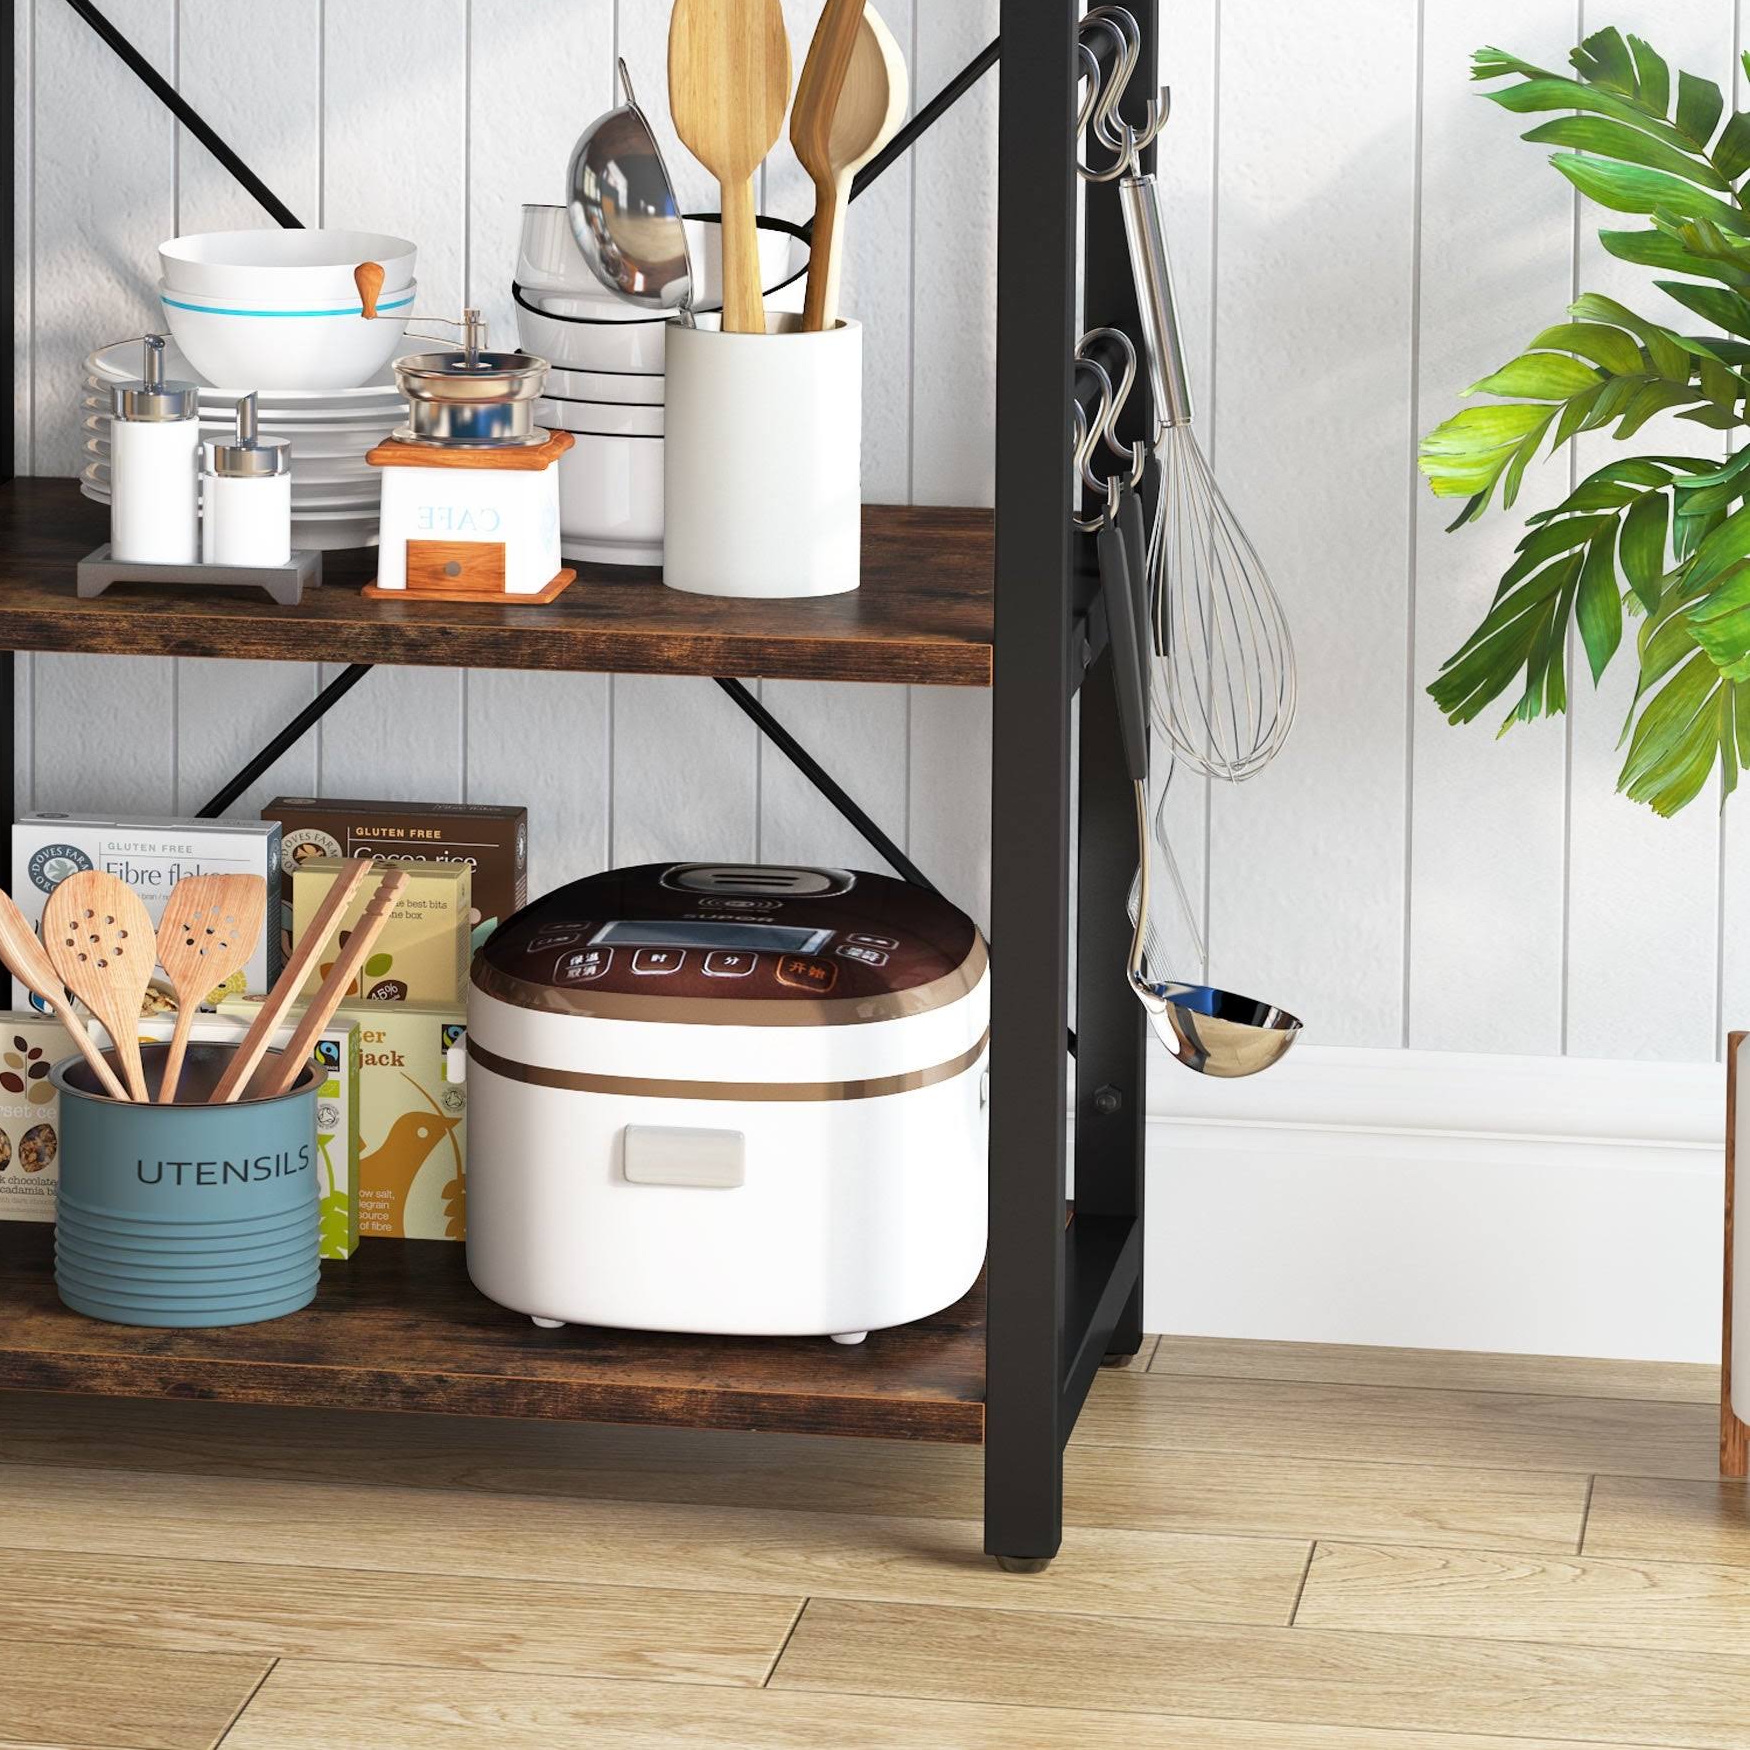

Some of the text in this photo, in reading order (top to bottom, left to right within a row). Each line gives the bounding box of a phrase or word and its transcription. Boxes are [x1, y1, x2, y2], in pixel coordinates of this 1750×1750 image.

[356, 827, 441, 839] GLUTEN FREE
[107, 842, 193, 853] GLUTEN FREE
[282, 832, 311, 856] DOVES
[32, 847, 62, 871] DOVES
[407, 899, 428, 909] best
[429, 900, 448, 910] bits
[390, 911, 423, 920] ne box
[789, 960, 827, 980] 开始
[137, 1144, 309, 1186] UTENSILS
[376, 1189, 395, 1201] salt,
[360, 1221, 393, 1232] of fibre
